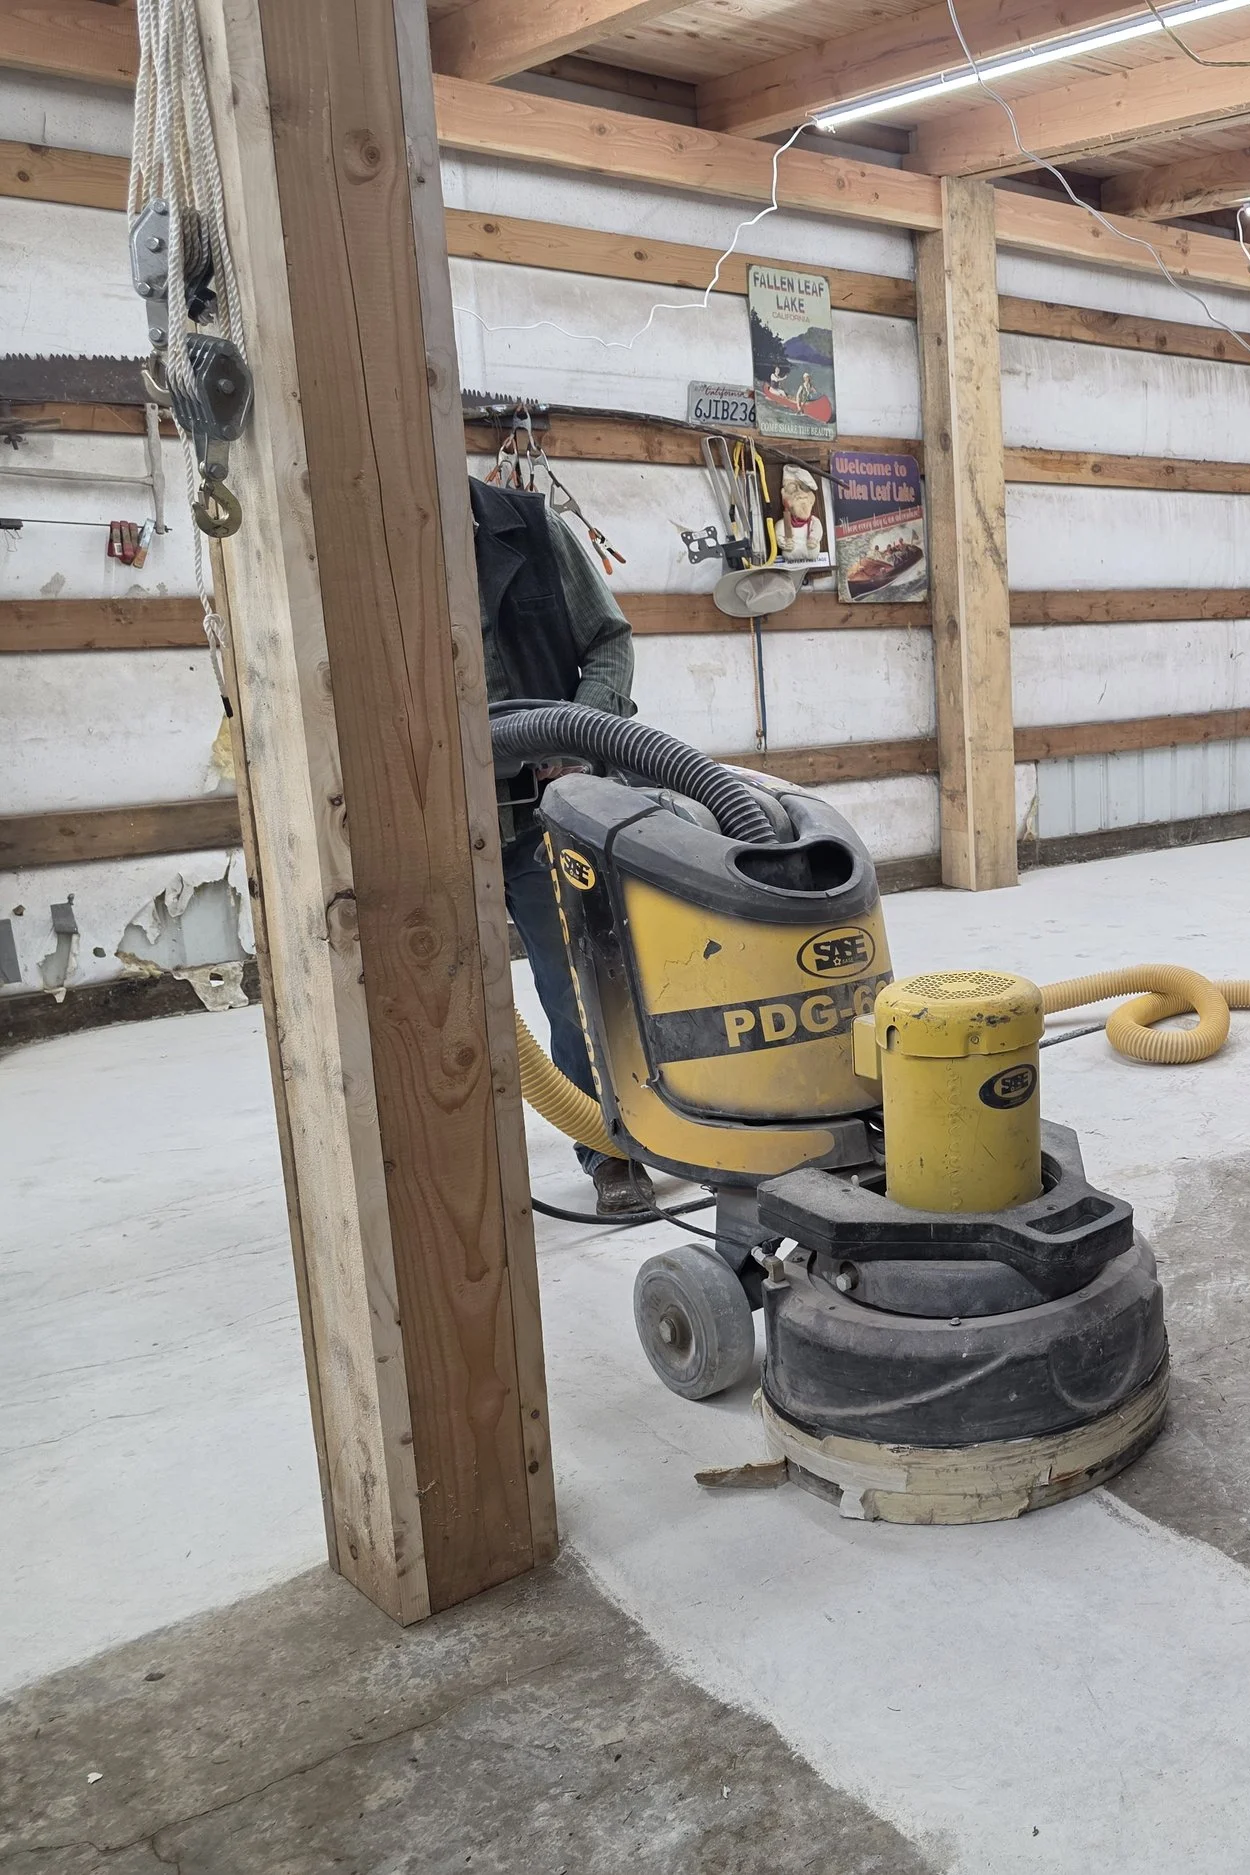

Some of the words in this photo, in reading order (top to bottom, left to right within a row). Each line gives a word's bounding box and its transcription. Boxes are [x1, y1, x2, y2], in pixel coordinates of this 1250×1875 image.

[753, 271, 795, 293] FALLEN
[797, 279, 824, 297] LEAF
[776, 294, 805, 314] LAKE
[772, 312, 810, 323] CALIFORNIA
[704, 385, 749, 399] California
[694, 398, 756, 422] 6JIB236
[760, 422, 779, 432] COME
[779, 423, 798, 434] SHARE
[798, 425, 810, 435] THE
[835, 457, 892, 477] Welcome
[893, 461, 907, 477] to
[837, 479, 868, 500] Fallen
[869, 480, 891, 502] Leaf
[892, 481, 916, 503] Lake
[813, 934, 868, 972] SASE
